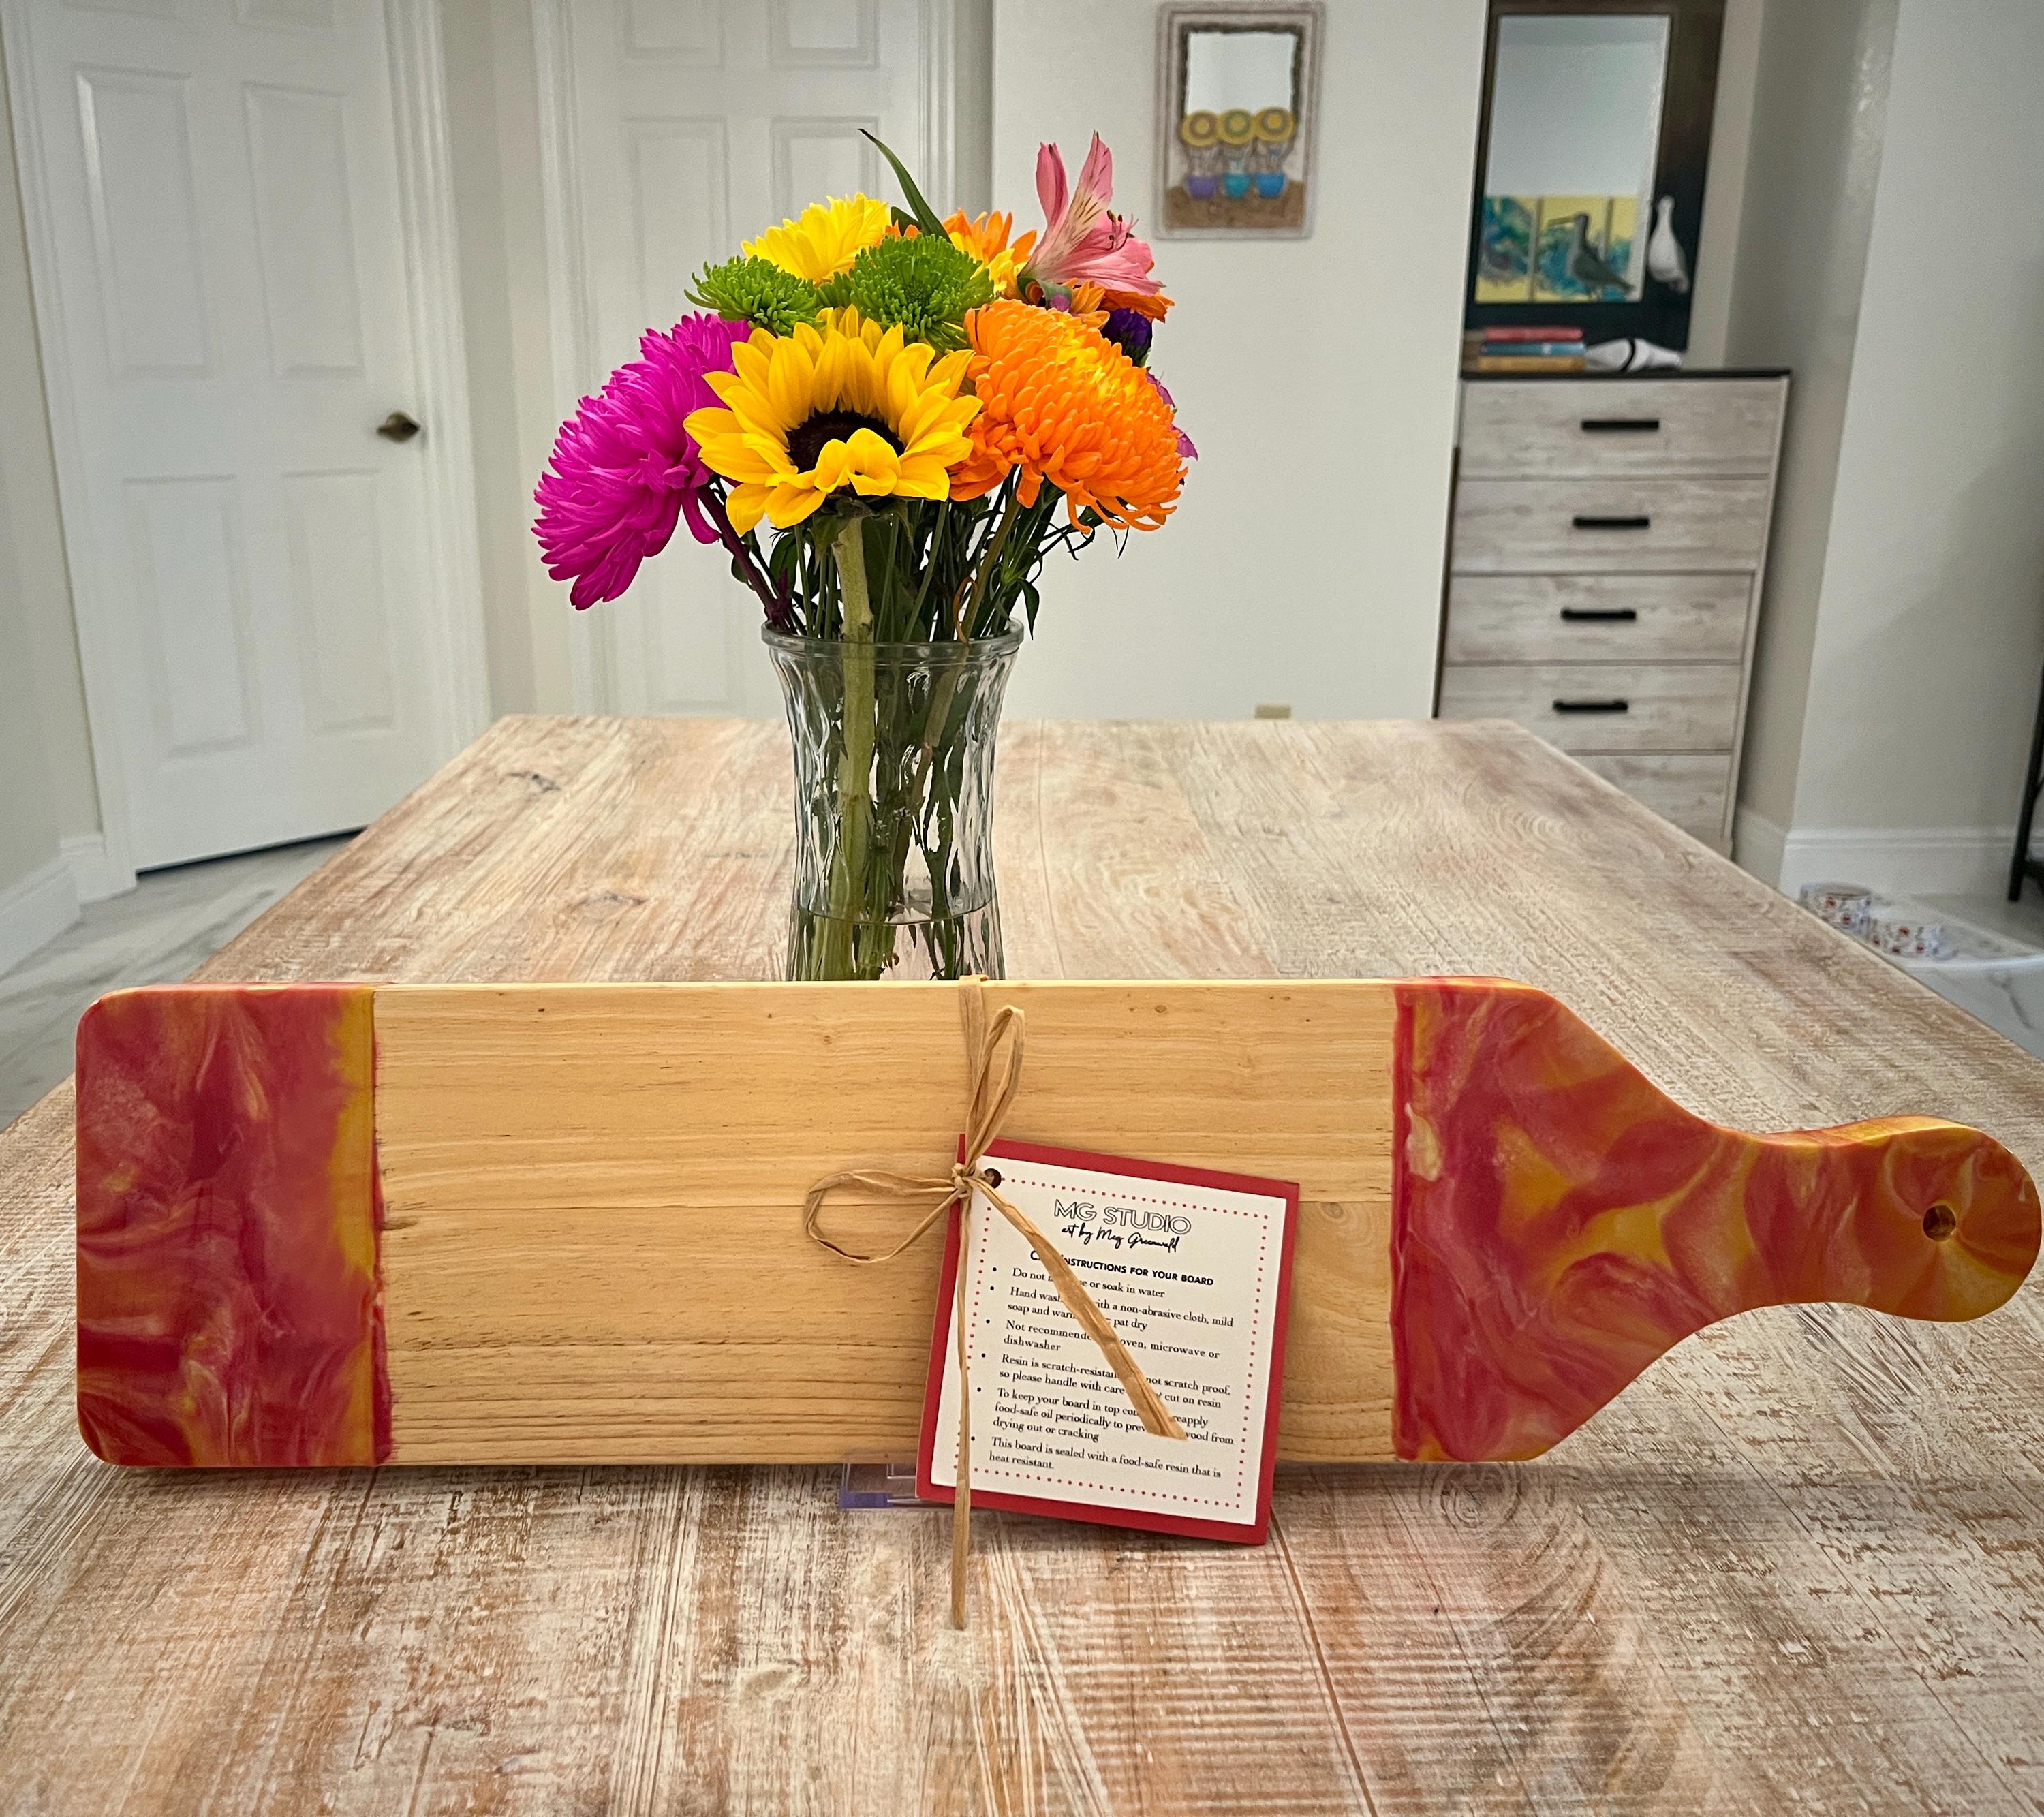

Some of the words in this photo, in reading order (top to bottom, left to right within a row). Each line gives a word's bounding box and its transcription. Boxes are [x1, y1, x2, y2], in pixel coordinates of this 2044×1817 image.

[1054, 1199, 1097, 1221] MG
[1103, 1206, 1192, 1234] STUDIO
[1079, 1222, 1093, 1245] by
[1096, 1227, 1124, 1249] Meg
[1012, 1267, 1027, 1278] Do
[1029, 1272, 1045, 1281] not
[1089, 1280, 1100, 1288] or
[1102, 1282, 1124, 1292] soak
[1126, 1284, 1135, 1294] in
[1138, 1288, 1166, 1298] water
[1061, 1254, 1126, 1273] NSTRUCTIONS
[1130, 1267, 1149, 1276] FOR
[1152, 1270, 1178, 1281] YOUR
[1181, 1274, 1214, 1286] BOARD
[1008, 1304, 1029, 1315] soap
[1032, 1306, 1049, 1316] and
[1113, 1318, 1128, 1328] pat
[1131, 1318, 1148, 1331] dry
[1010, 1286, 1036, 1299] Hand
[1095, 1298, 1110, 1309] ith
[1121, 1305, 1181, 1320] non-abrasive
[1183, 1311, 1209, 1324] cloth,
[1212, 1317, 1233, 1326] mild
[1004, 1335, 1061, 1351] dishwasher
[1006, 1319, 1025, 1331] Not
[1120, 1339, 1147, 1349] oven,
[1150, 1341, 1205, 1357] microwave
[1208, 1351, 1220, 1359] or
[1002, 1354, 1027, 1366] Resin
[1031, 1358, 1039, 1367] is
[1042, 1362, 1117, 1379] scratch-resistan
[1146, 1377, 1161, 1386] not
[1164, 1379, 1199, 1391] scratch
[1202, 1385, 1230, 1396] proof,
[1012, 1369, 1042, 1382] please
[1045, 1373, 1077, 1388] handle
[1081, 1380, 1101, 1391] with
[1104, 1386, 1125, 1395] care
[1164, 1393, 1179, 1402] cut
[1183, 1397, 1194, 1405] on
[1198, 1398, 1221, 1408] resin
[997, 1387, 1010, 1398] To
[1012, 1388, 1035, 1403] keep
[1035, 1396, 1059, 1405] your
[1062, 1396, 1089, 1410] board
[1092, 1401, 1101, 1410] in
[1104, 1404, 1120, 1416] top
[993, 1416, 1025, 1432] drying
[1027, 1423, 1042, 1432] out
[1045, 1426, 1056, 1434] or
[1058, 1427, 1100, 1443] cracking
[995, 1401, 1038, 1416] food-safe
[1041, 1409, 1053, 1419] oil
[1055, 1412, 1111, 1429] periodically
[1113, 1420, 1124, 1429] to
[1211, 1432, 1234, 1445] from
[989, 1450, 1010, 1463] heat
[1012, 1456, 1054, 1470] resistant.
[991, 1436, 1012, 1448] This
[1015, 1439, 1042, 1453] board
[1045, 1444, 1053, 1454] is
[1055, 1446, 1085, 1459] sealed
[1087, 1450, 1108, 1462] with
[1119, 1453, 1164, 1470] food-safe
[1166, 1463, 1189, 1473] resin
[1192, 1465, 1211, 1477] that
[1213, 1467, 1222, 1478] is
